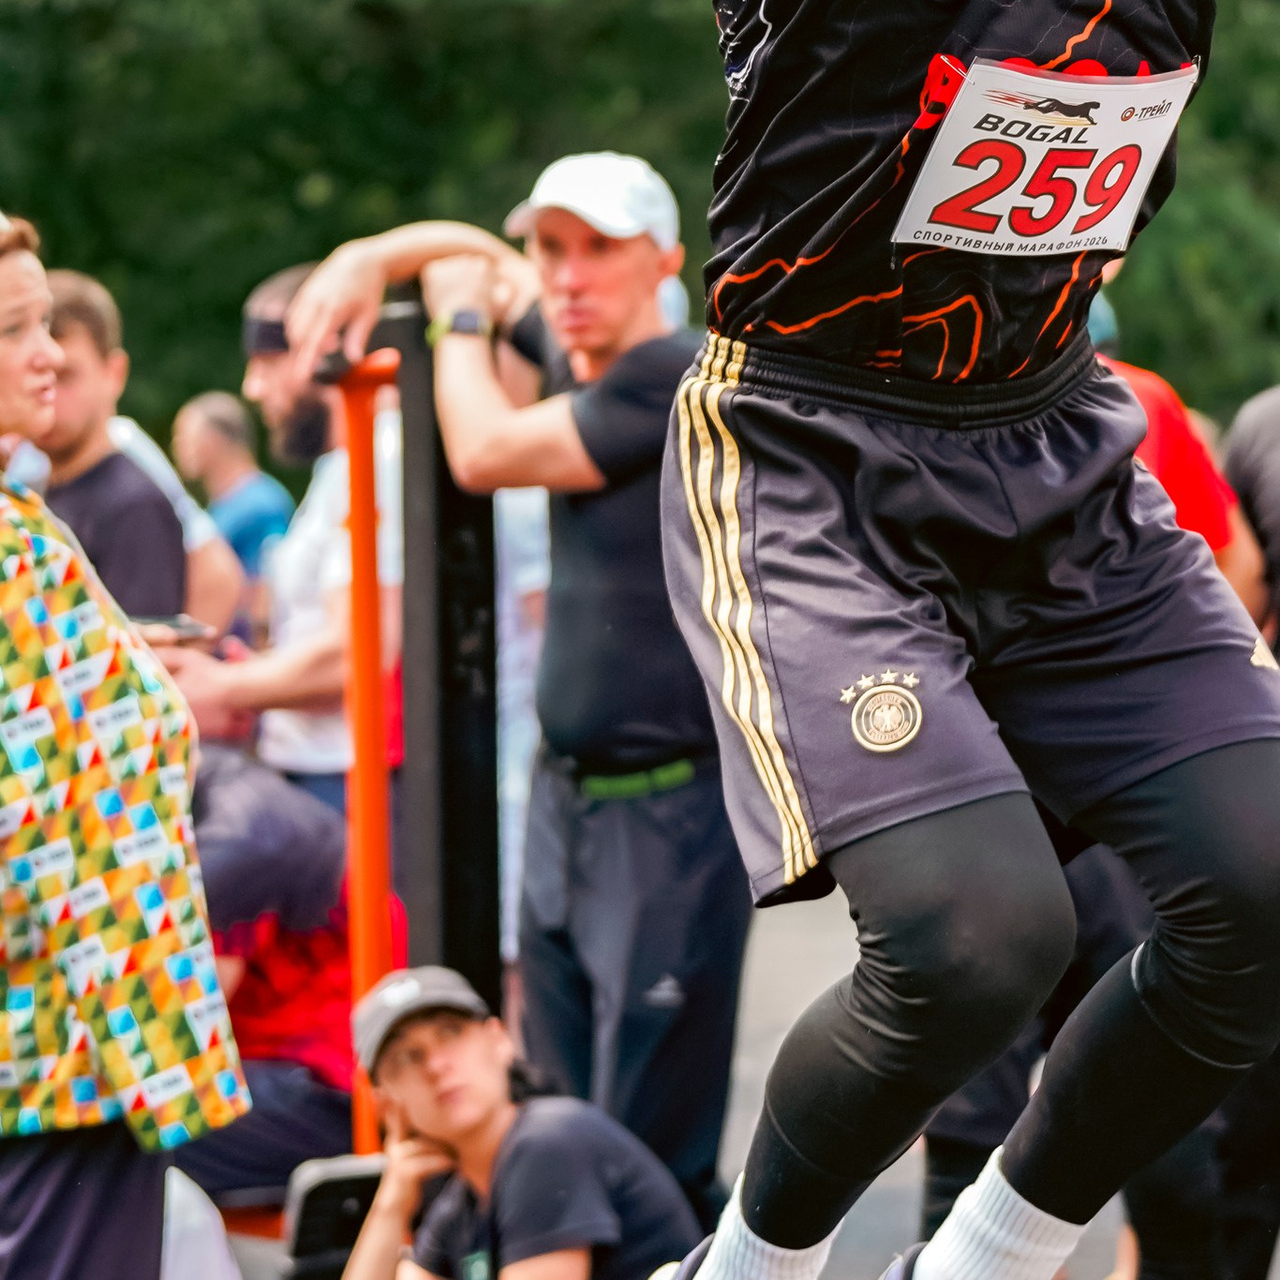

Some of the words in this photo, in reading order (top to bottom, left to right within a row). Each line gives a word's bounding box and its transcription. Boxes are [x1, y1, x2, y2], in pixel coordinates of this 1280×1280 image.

[972, 113, 1089, 144] BOGAL
[927, 138, 1143, 238] 259
[913, 230, 1015, 252] СПОРТИВНЫЙ
[1016, 238, 1082, 253] МАРАФОН
